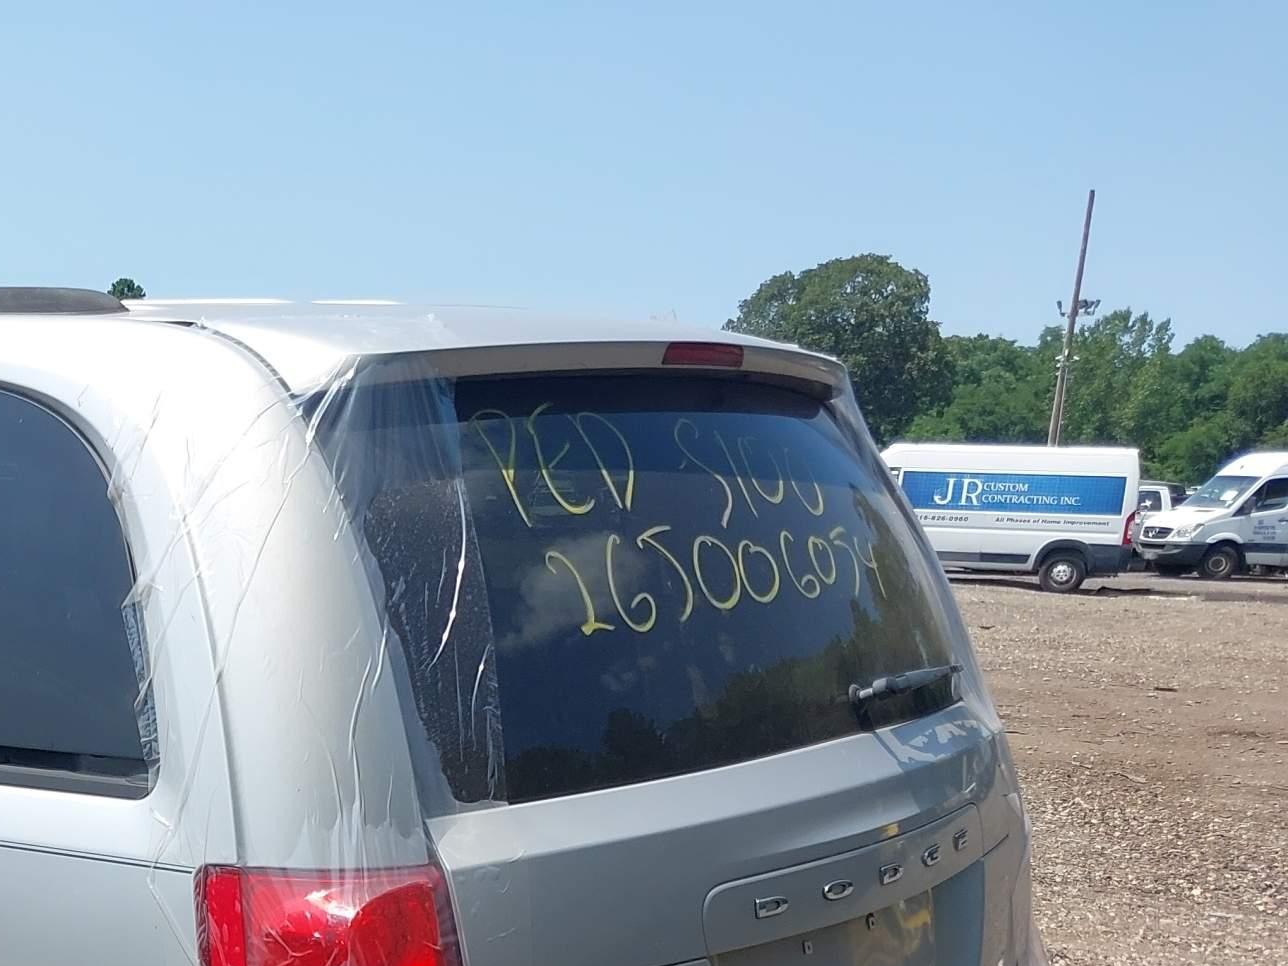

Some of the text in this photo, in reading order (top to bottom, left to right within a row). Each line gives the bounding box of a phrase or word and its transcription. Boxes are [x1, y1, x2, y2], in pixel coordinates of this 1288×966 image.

[983, 482, 1030, 493] CUSTOM
[982, 494, 1058, 505] CONTRACTING
[754, 829, 969, 919] DODGE
